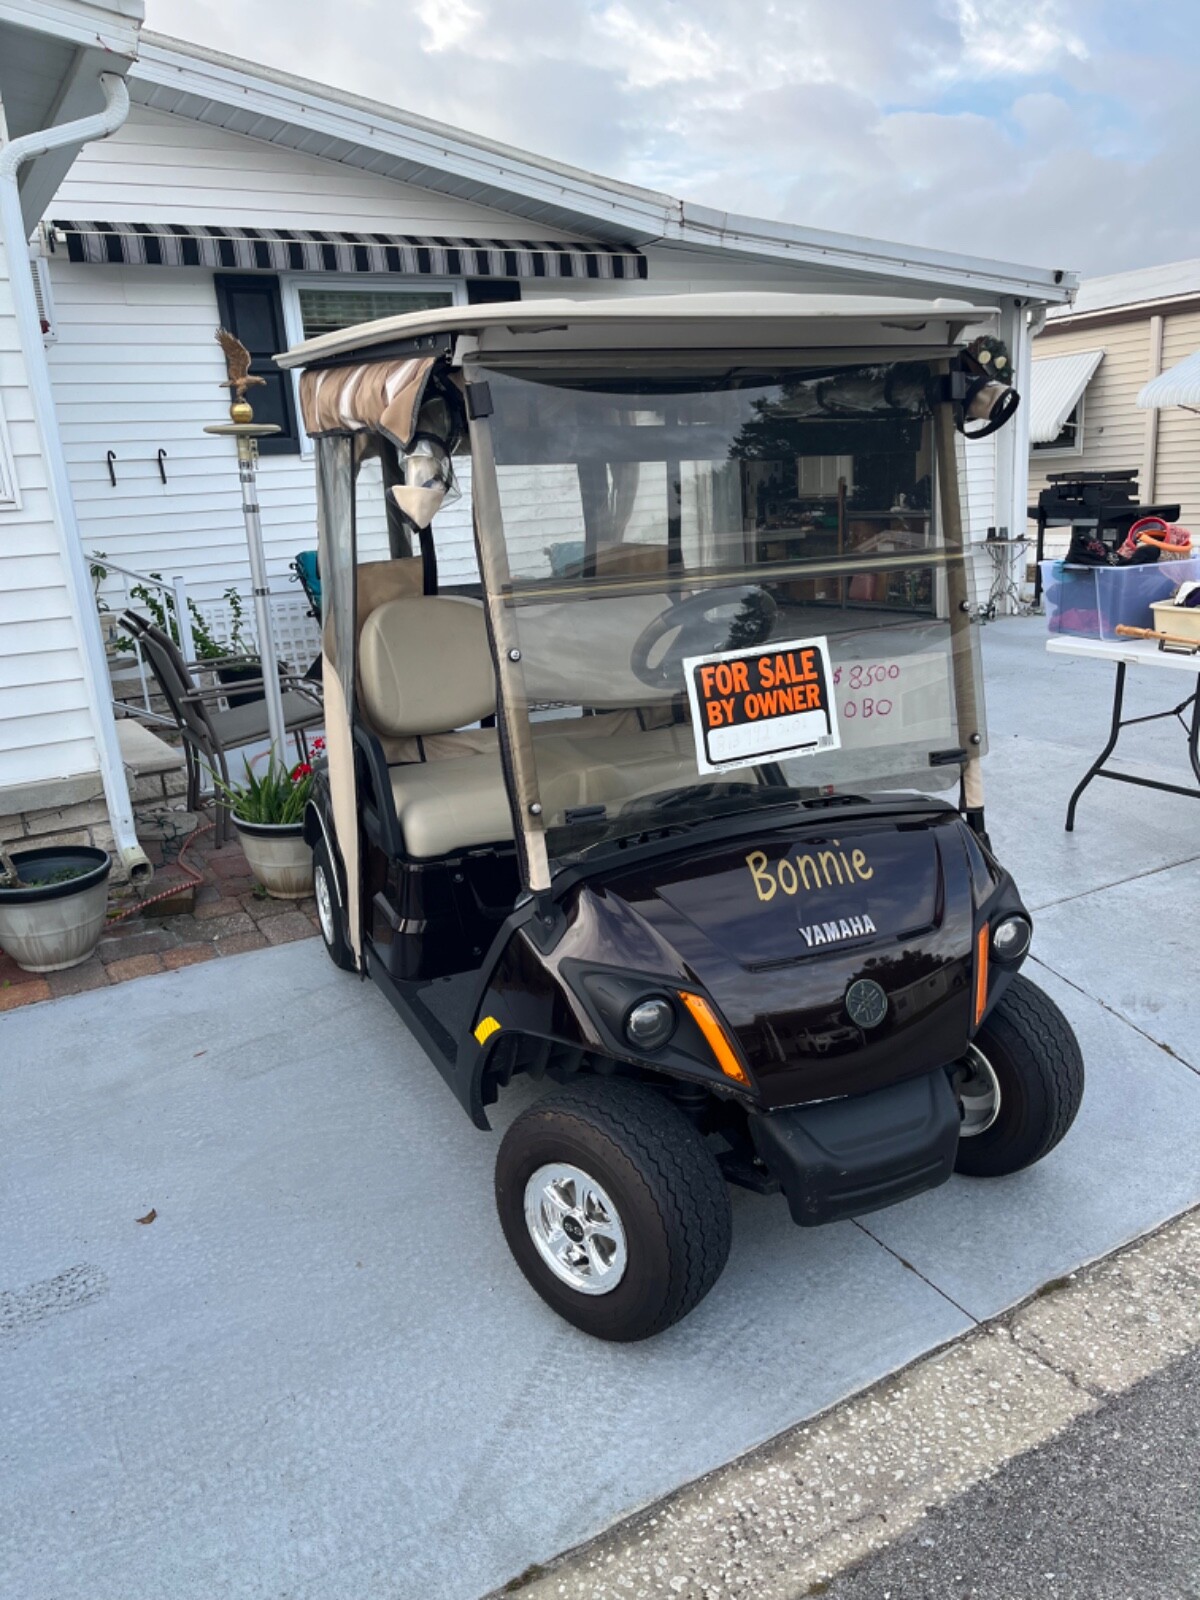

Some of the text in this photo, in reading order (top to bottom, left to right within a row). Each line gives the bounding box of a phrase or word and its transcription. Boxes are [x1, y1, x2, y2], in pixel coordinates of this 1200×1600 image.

[701, 650, 818, 698] FOR SALE
[706, 683, 821, 727] BY OWNER
[844, 698, 893, 718] OBO
[746, 839, 874, 901] Bonnie
[798, 914, 877, 947] YAMAHA
